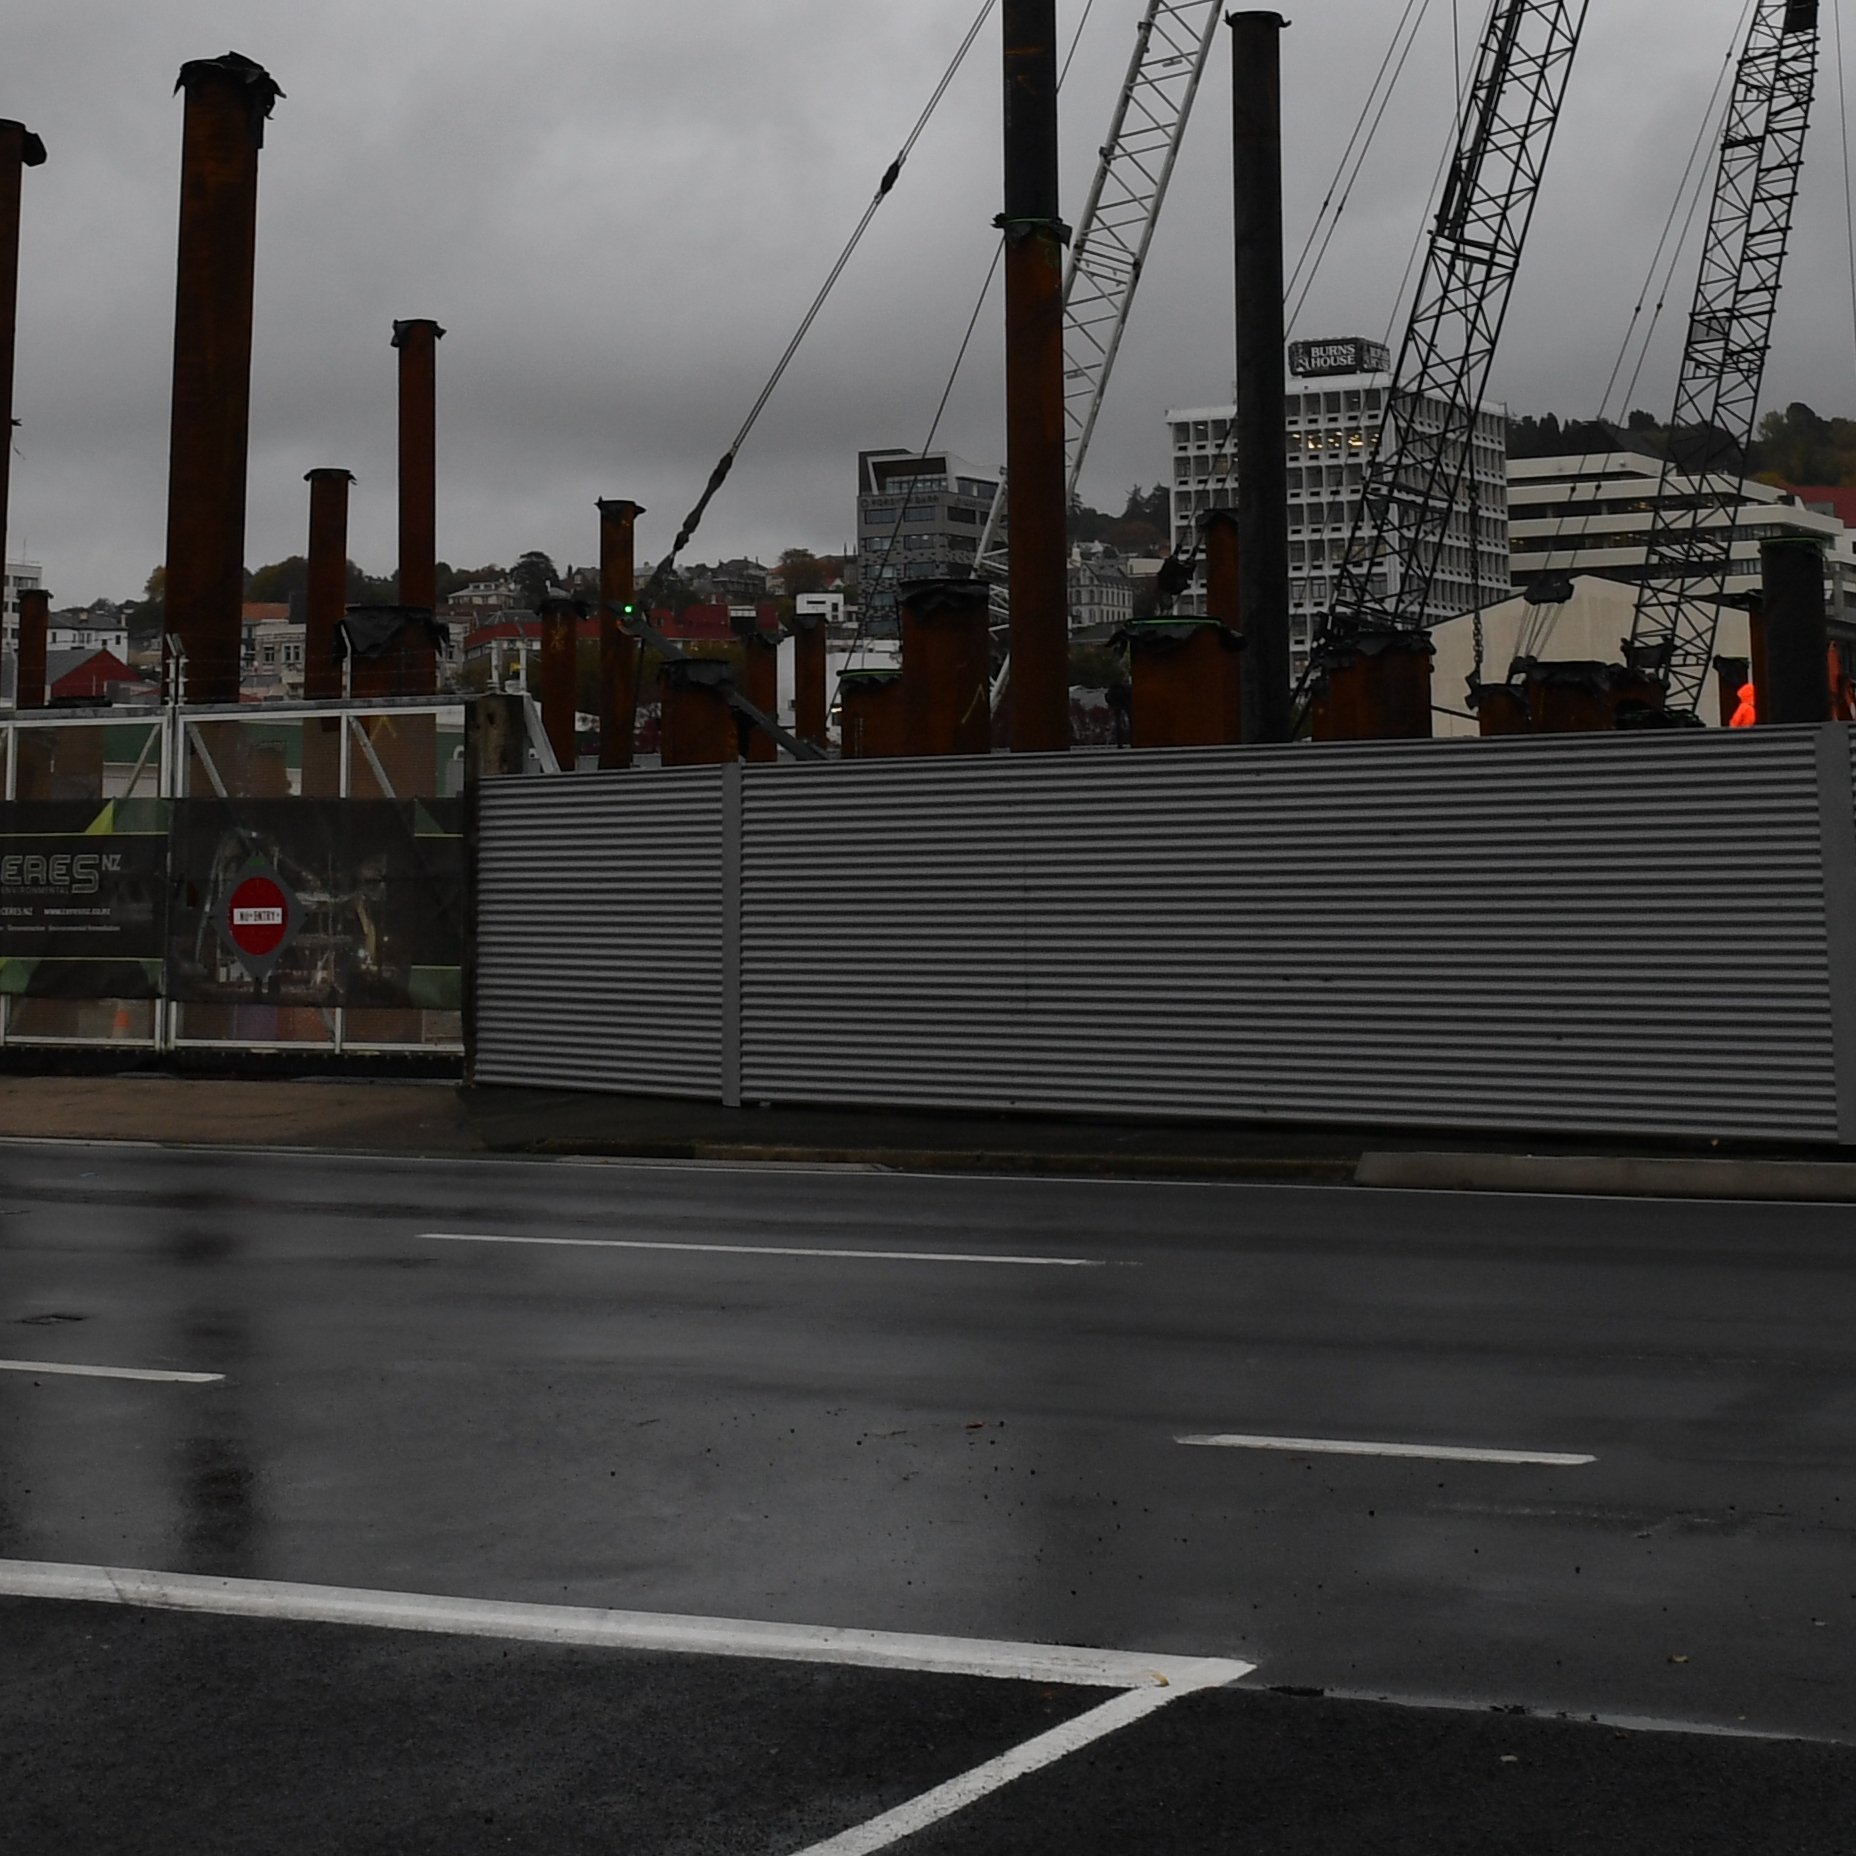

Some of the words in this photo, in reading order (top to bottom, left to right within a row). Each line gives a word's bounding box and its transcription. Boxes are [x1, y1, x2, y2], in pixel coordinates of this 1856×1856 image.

[1310, 344, 1357, 358] BURNS
[1310, 354, 1357, 368] HOUSE
[101, 854, 123, 871] NZ
